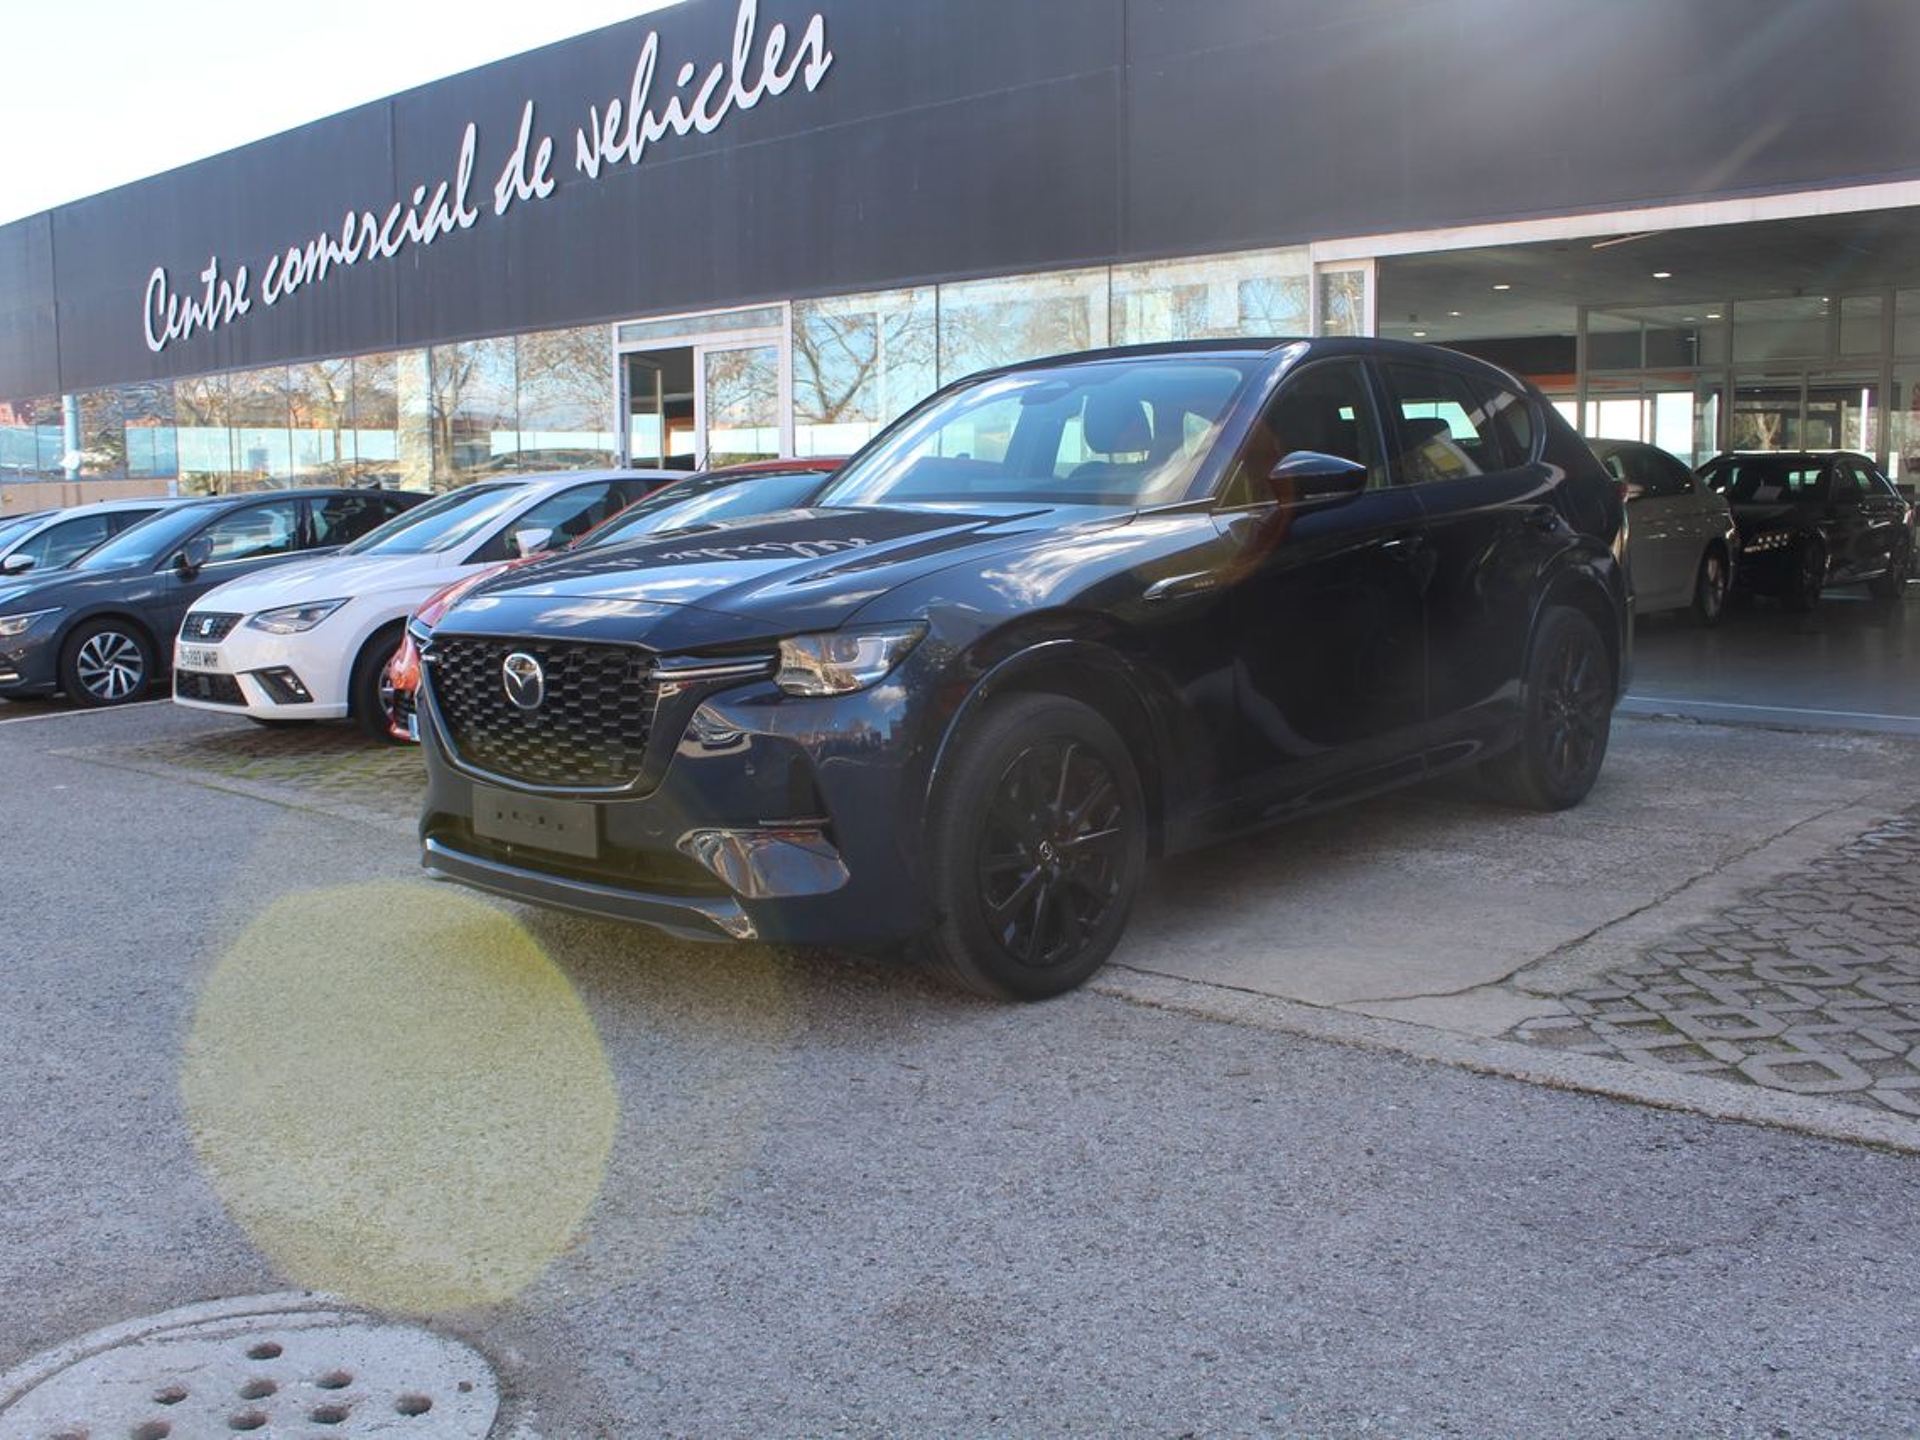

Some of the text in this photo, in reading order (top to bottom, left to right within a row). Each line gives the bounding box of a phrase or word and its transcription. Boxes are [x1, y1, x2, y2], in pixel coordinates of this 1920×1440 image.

[144, 0, 833, 352] Centre comercial de vehicles
